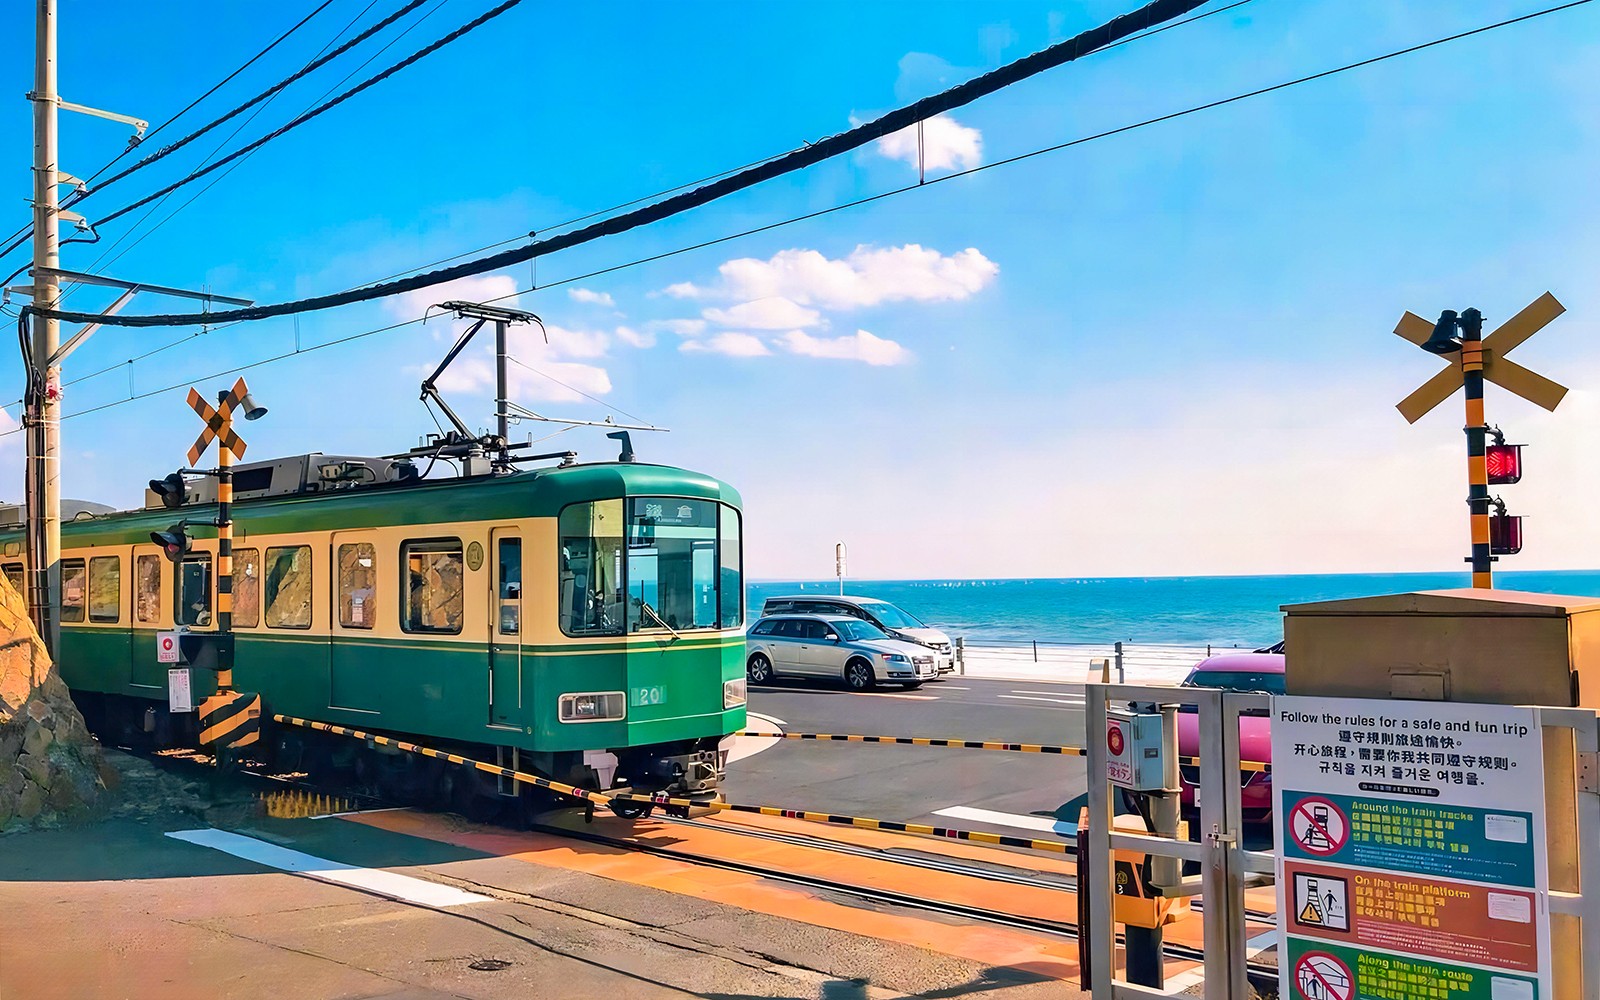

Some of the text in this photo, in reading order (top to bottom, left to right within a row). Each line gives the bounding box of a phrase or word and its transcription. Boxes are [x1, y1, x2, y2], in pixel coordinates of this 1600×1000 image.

[1281, 711, 1528, 738] Follow the rules for a safe and fun trip
[1319, 761, 1355, 775] 규칙을
[1361, 764, 1386, 778] 지켜
[1391, 766, 1431, 781] 즐거운
[1352, 801, 1389, 813] Around
[1391, 805, 1408, 815] the
[1411, 807, 1436, 818] train
[1354, 875, 1370, 885] On
[1373, 878, 1391, 888] the
[1393, 880, 1419, 892] train
[1422, 884, 1471, 899] platform
[1358, 953, 1389, 969] Along
[1392, 960, 1411, 971] the
[1413, 963, 1439, 976] train
